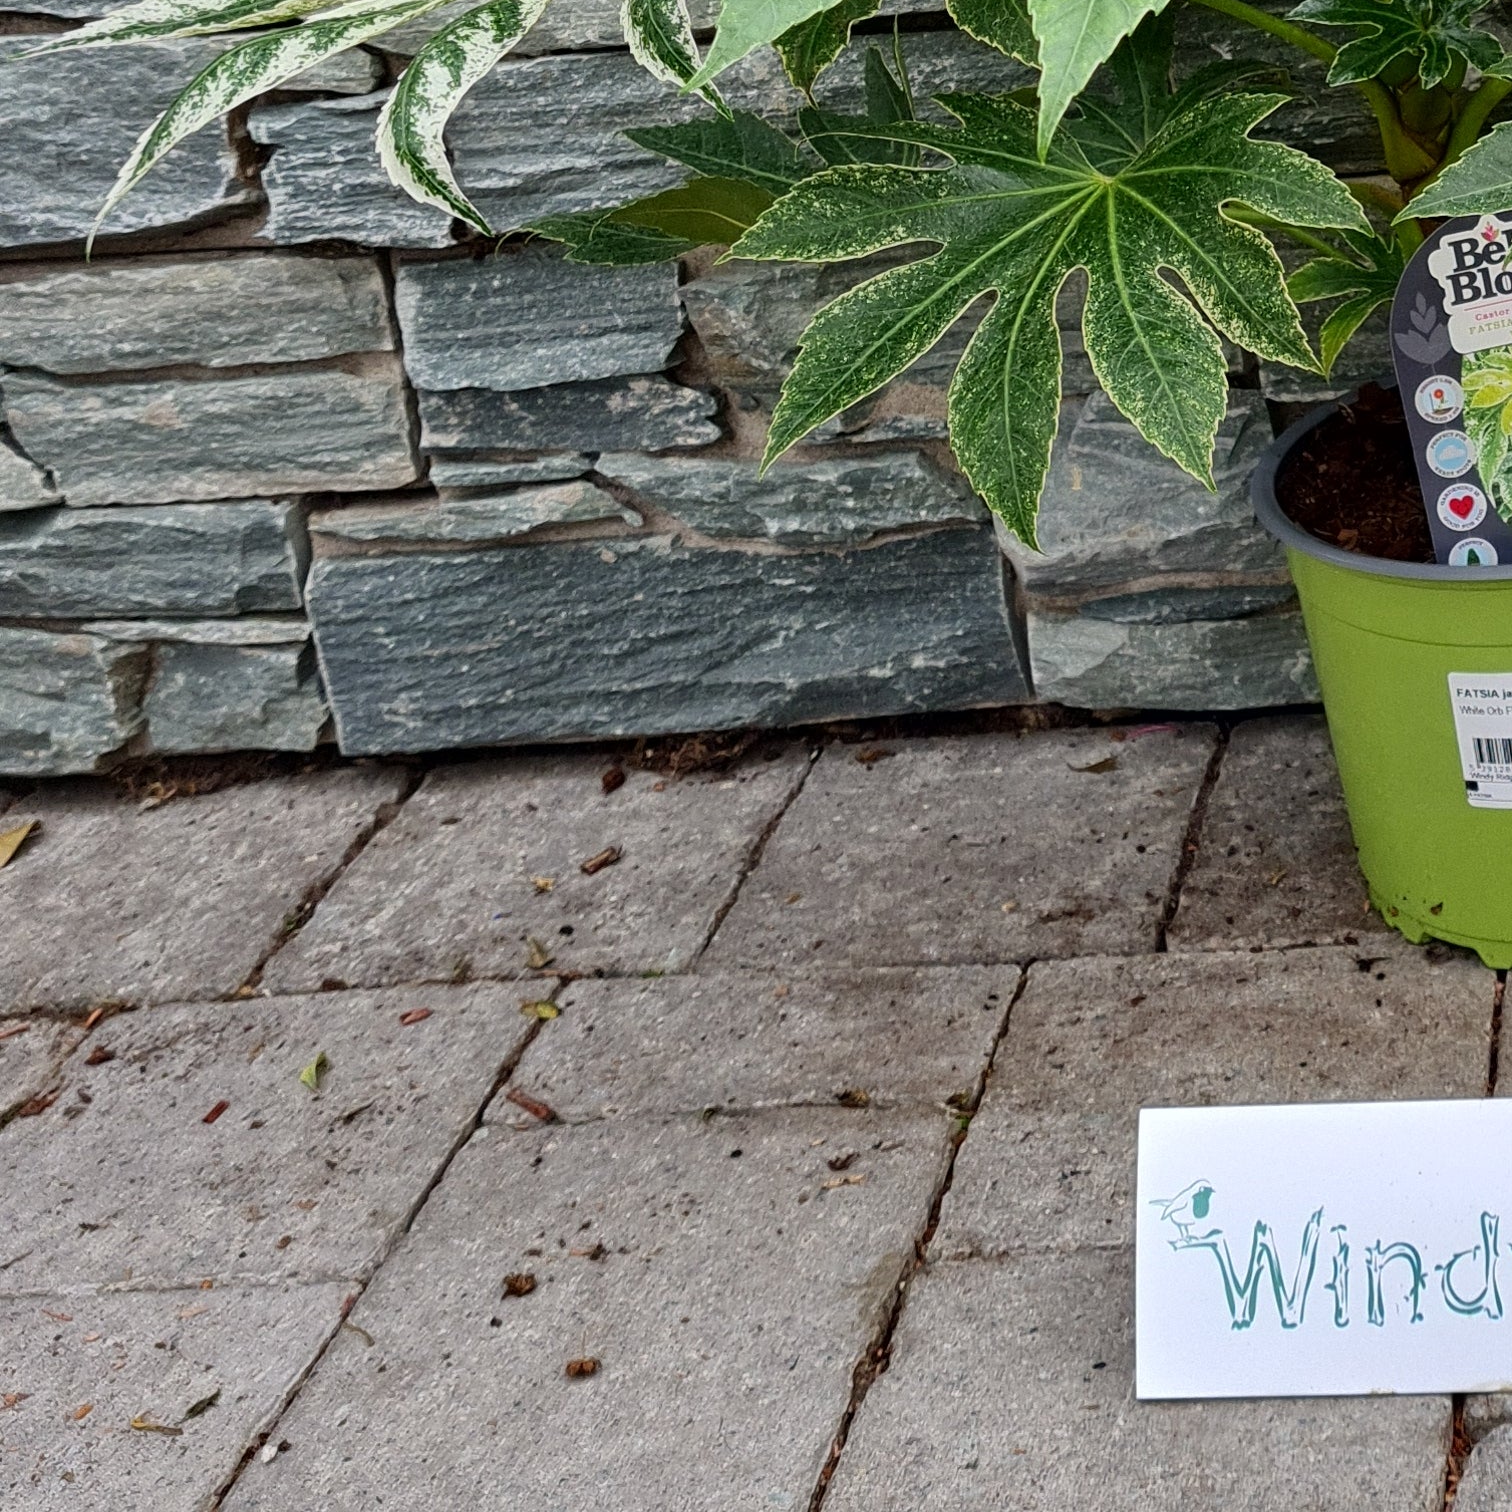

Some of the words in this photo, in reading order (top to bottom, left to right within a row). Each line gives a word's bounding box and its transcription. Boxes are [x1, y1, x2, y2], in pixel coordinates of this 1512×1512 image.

[1474, 308, 1510, 321] Castor
[1456, 688, 1500, 699] FATSIA
[1460, 704, 1486, 716] White
[1486, 705, 1504, 716] Orb
